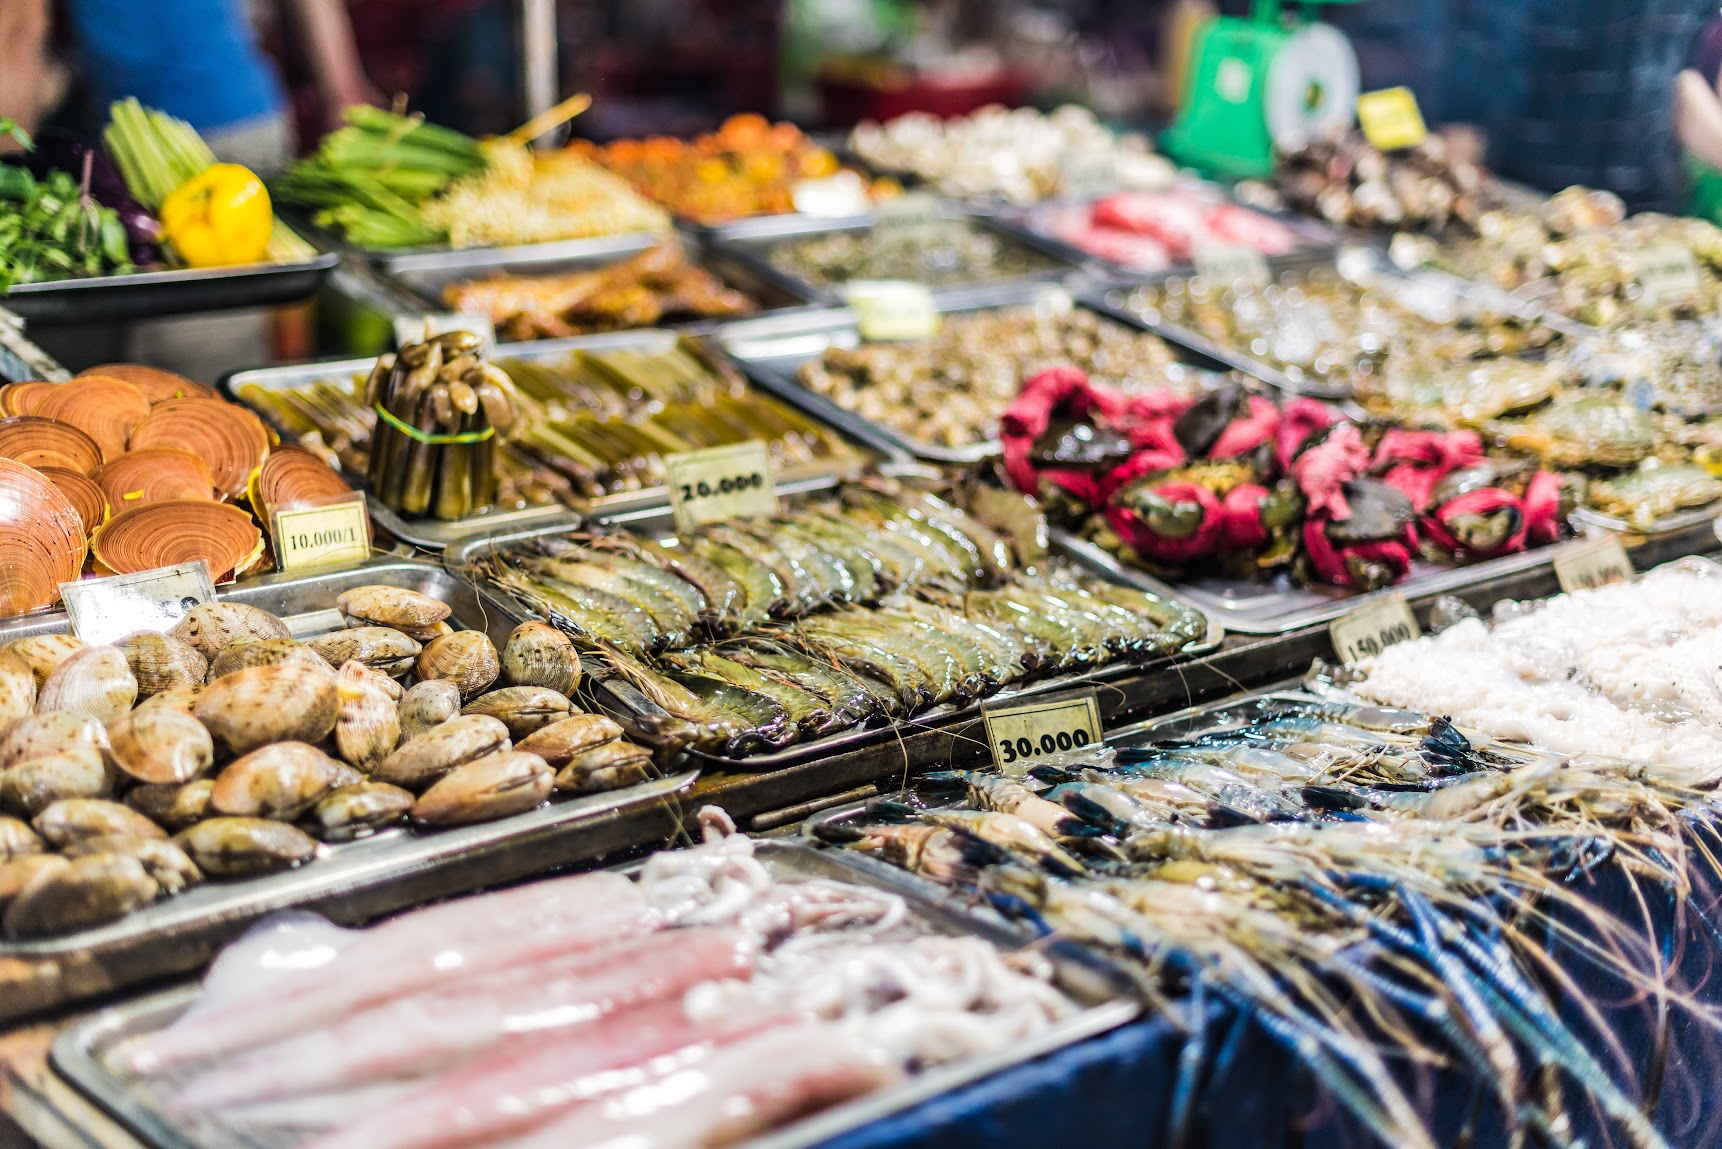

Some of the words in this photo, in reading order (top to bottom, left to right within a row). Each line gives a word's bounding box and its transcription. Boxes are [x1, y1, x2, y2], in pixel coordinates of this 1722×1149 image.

[681, 472, 763, 502] 20.000
[1347, 621, 1412, 663] 150000
[999, 728, 1090, 763] 30.000
